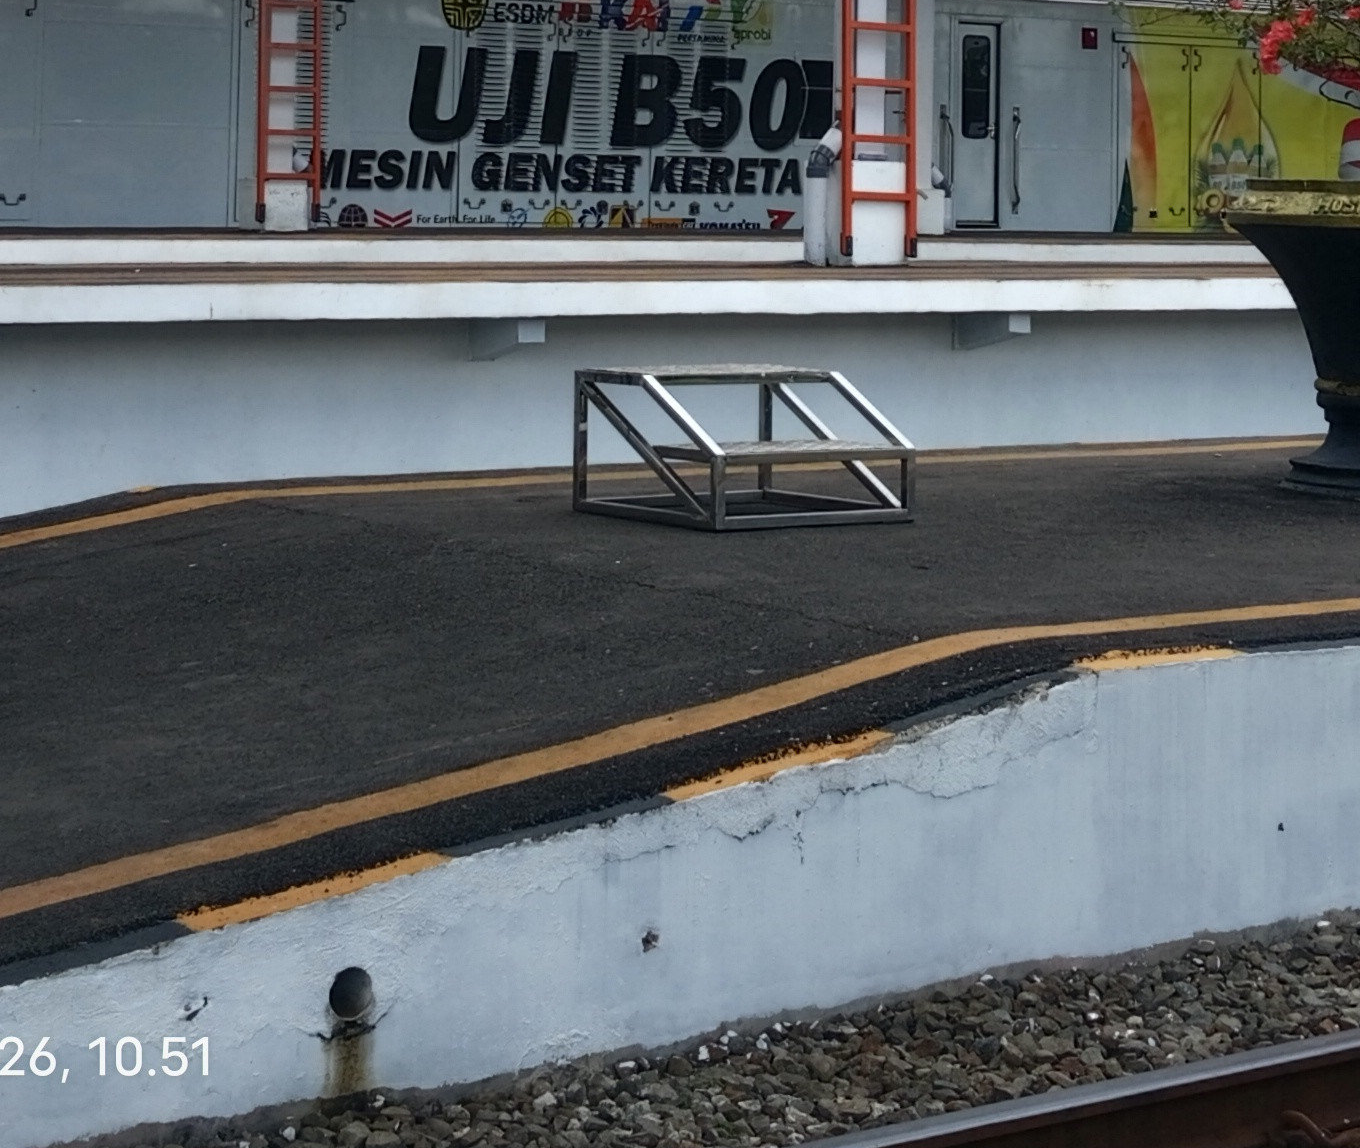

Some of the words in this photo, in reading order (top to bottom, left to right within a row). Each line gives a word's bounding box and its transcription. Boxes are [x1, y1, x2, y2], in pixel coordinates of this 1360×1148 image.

[493, 2, 555, 24] ESDM
[408, 45, 578, 144] UJI
[609, 54, 807, 152] B50
[308, 149, 456, 190] MESIN
[471, 152, 641, 193] GENSET
[650, 155, 803, 195] KERETA
[416, 214, 432, 223] For
[462, 215, 478, 224] For
[479, 214, 496, 224] Life
